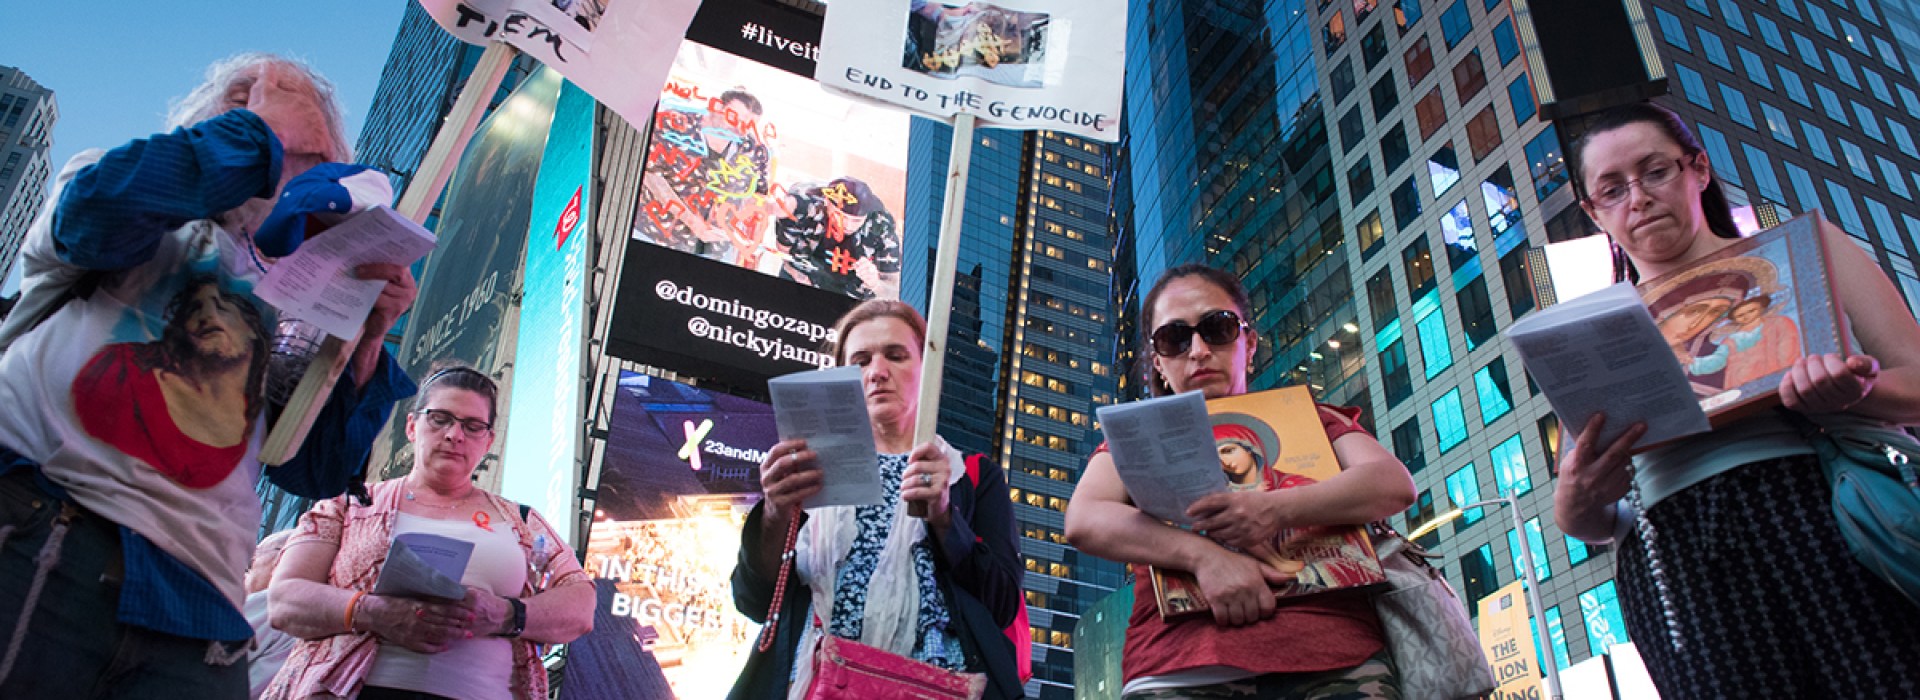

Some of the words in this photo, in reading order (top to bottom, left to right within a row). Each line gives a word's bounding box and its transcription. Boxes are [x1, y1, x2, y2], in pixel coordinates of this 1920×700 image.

[741, 21, 820, 62] #liveit
[845, 66, 893, 91] END
[901, 84, 928, 102] TO
[936, 90, 983, 110] THE
[988, 100, 1108, 132] GENOCIDE
[411, 304, 460, 366] SINCE
[458, 270, 498, 327] 1960
[655, 279, 838, 342] @domingozapa
[687, 316, 836, 371] @nickyjamp
[704, 440, 768, 464] 23andM
[597, 555, 632, 583] IN
[1491, 637, 1518, 658] THE
